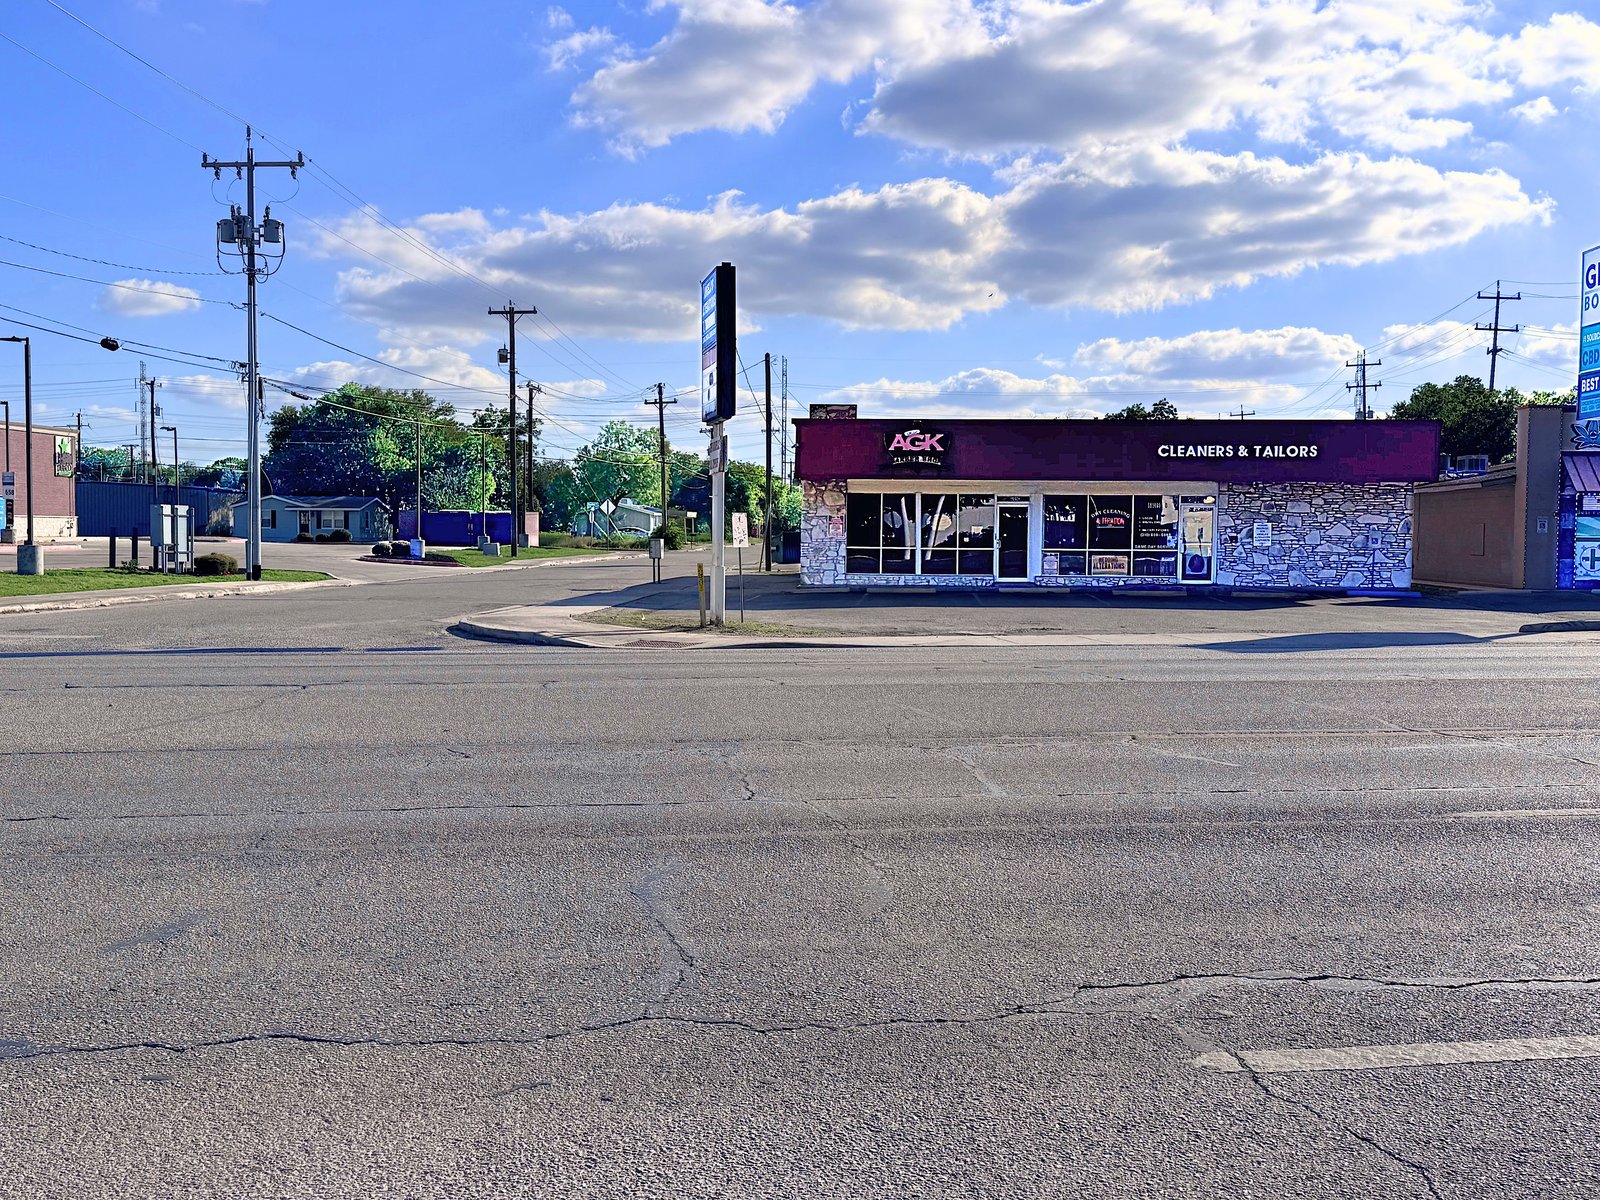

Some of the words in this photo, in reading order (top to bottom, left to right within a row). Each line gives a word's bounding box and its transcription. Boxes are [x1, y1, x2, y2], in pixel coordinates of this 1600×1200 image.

[1586, 262, 1600, 289] G
[1583, 349, 1599, 366] CBD
[1581, 376, 1599, 393] BEST
[888, 433, 944, 451] AGK
[1157, 444, 1234, 458] CLEANERS
[1237, 444, 1249, 458] &
[1253, 444, 1318, 458] TAILORS
[1103, 508, 1131, 519] CLEANING
